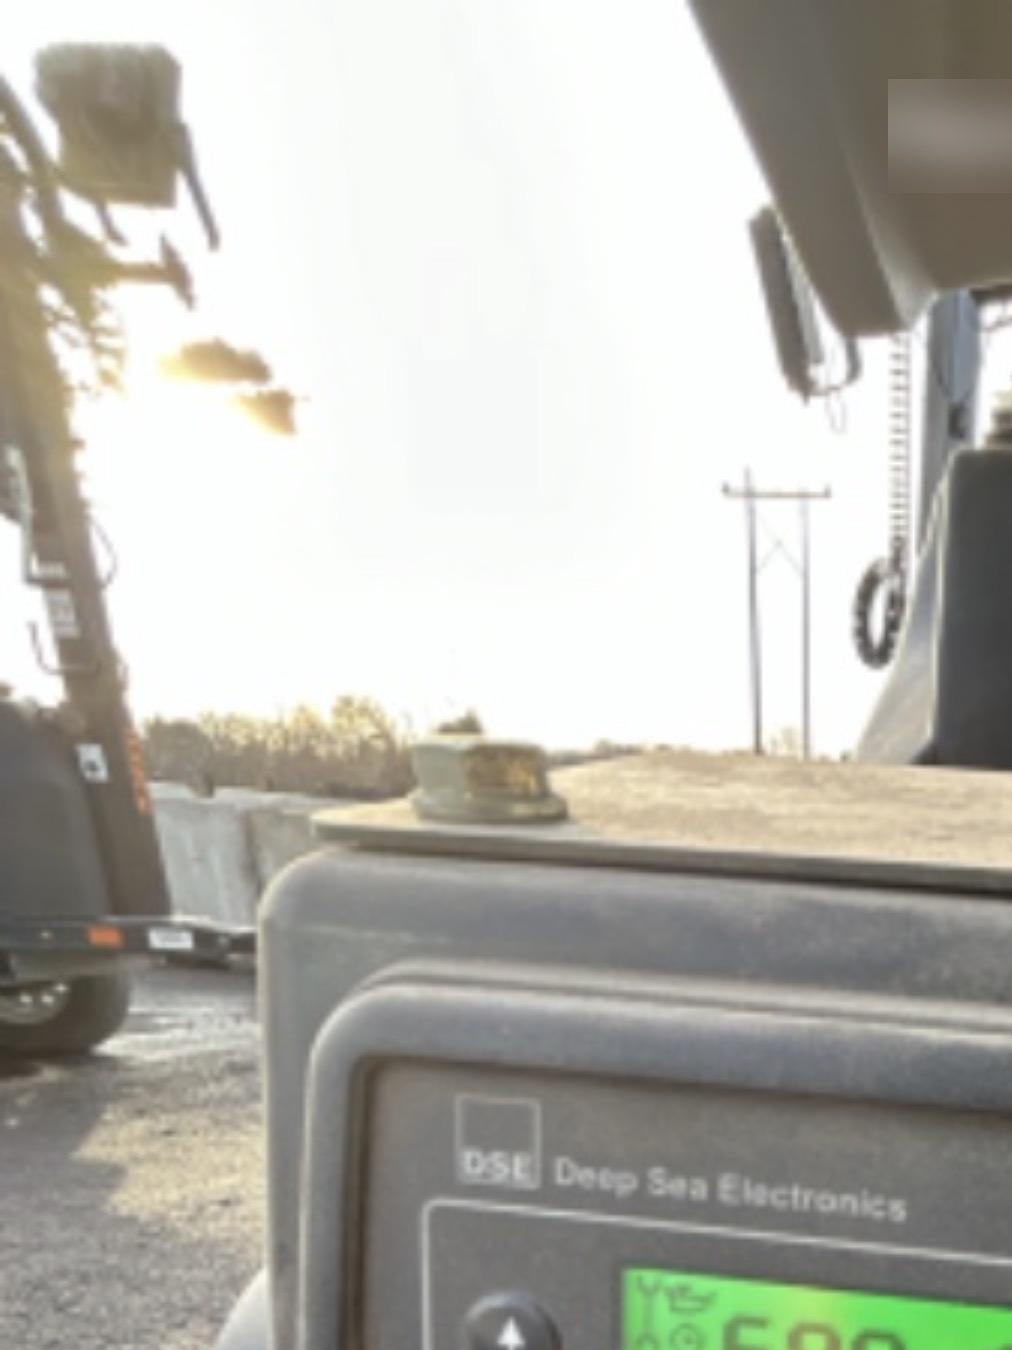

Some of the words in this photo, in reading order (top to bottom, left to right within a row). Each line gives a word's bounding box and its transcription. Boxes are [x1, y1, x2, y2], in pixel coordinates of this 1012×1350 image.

[462, 1148, 532, 1182] DSE
[554, 1156, 638, 1198] Deep
[647, 1165, 708, 1202] Sea
[716, 1172, 908, 1223] Electronics
